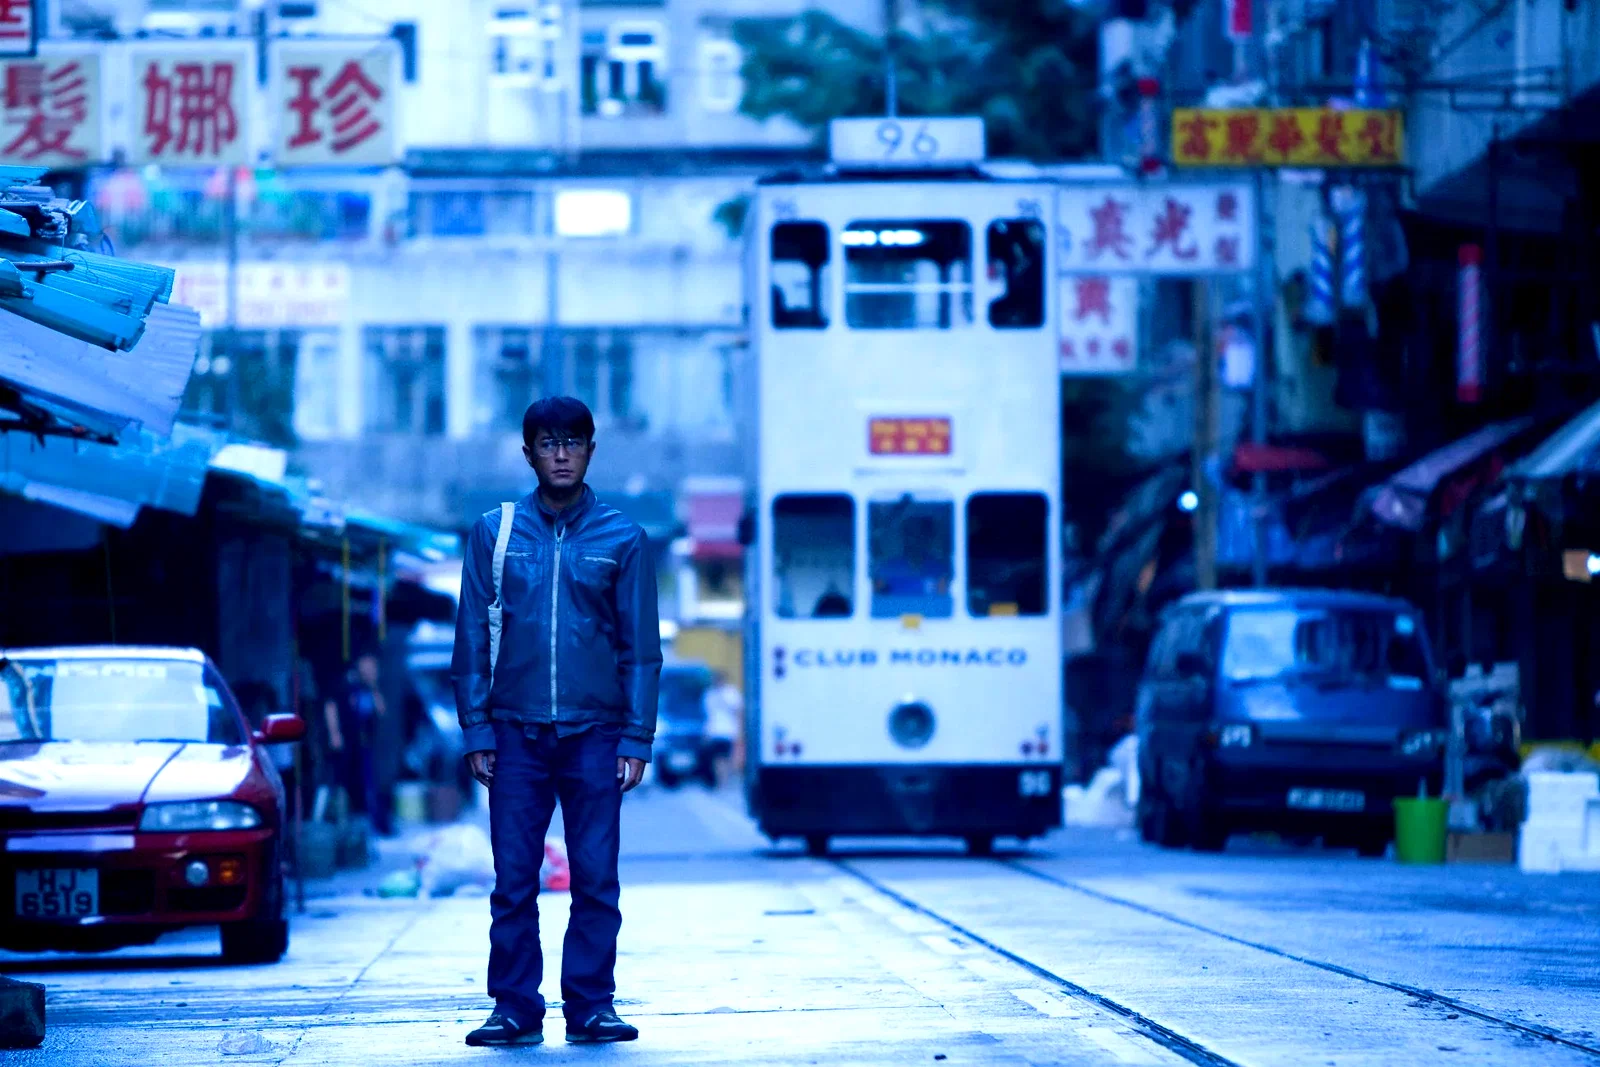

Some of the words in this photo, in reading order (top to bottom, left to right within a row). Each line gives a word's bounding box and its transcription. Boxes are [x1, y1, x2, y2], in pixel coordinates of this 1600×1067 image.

[877, 120, 940, 158] 96
[793, 648, 878, 667] CLUB
[890, 648, 1028, 667] MONACO
[37, 869, 77, 892] HJ
[22, 890, 93, 915] 6519
